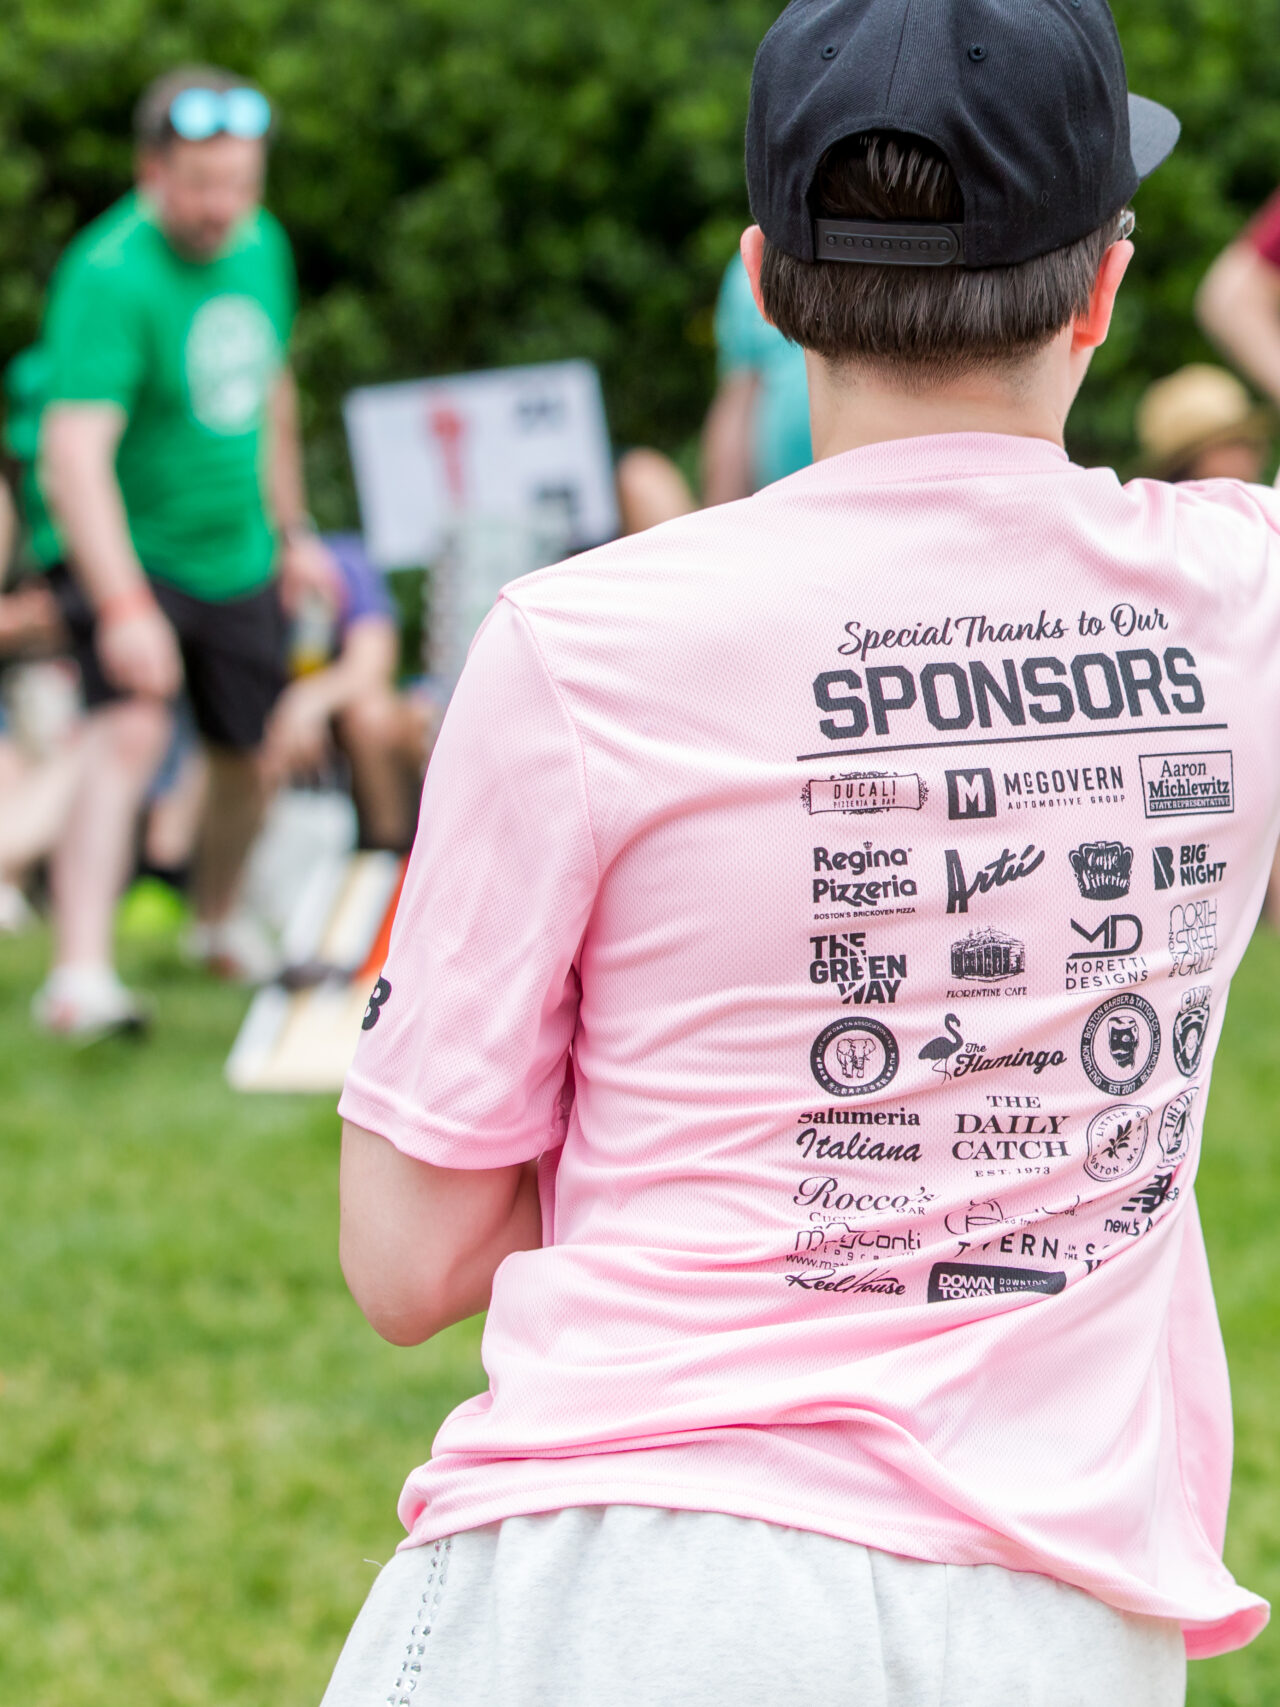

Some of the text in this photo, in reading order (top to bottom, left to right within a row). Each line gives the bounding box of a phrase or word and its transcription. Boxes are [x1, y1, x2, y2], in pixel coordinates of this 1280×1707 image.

[837, 603, 1168, 662] Special Thanks to Our
[812, 647, 1205, 740] SPONSORS
[1160, 760, 1207, 778] Aaron
[834, 780, 896, 799] DUCALI
[1148, 776, 1230, 798] Michlewitz
[833, 799, 868, 808] PIZZERIA
[1008, 794, 1126, 810] AUTOMOTIVE GROUP
[1150, 797, 1230, 810] STATE REPRESENTATIVE
[813, 846, 908, 875] Regina
[1180, 844, 1207, 865] BIG
[1180, 862, 1227, 886] NIGHT
[813, 874, 917, 907] Pizzeria
[810, 932, 866, 959] THE
[810, 954, 907, 984] GREEN
[1066, 957, 1147, 974] MORETTI
[1066, 970, 1148, 990] DESIGNS
[837, 980, 901, 1004] WAY
[946, 988, 1001, 998] FLORENTINE
[1084, 1008, 1104, 1039] BOSTON
[1103, 995, 1129, 1012] BARBER
[1135, 997, 1155, 1019] TATTOO
[965, 1042, 987, 1053] The
[953, 1047, 1067, 1078] Flamingo
[1082, 1045, 1102, 1086] NORTH END
[1140, 1054, 1158, 1083] BEACON
[1109, 1085, 1120, 1094] EST
[986, 1095, 1041, 1108] THE
[954, 1113, 1071, 1135] DAILY
[1096, 1111, 1128, 1137] LITTLE
[1164, 1105, 1181, 1128] THE
[796, 1127, 922, 1162] Italiana
[952, 1141, 1071, 1160] CATCH
[1017, 1166, 1050, 1175] 1973
[793, 1176, 935, 1211] Rocco's
[938, 1273, 995, 1290] DOWN
